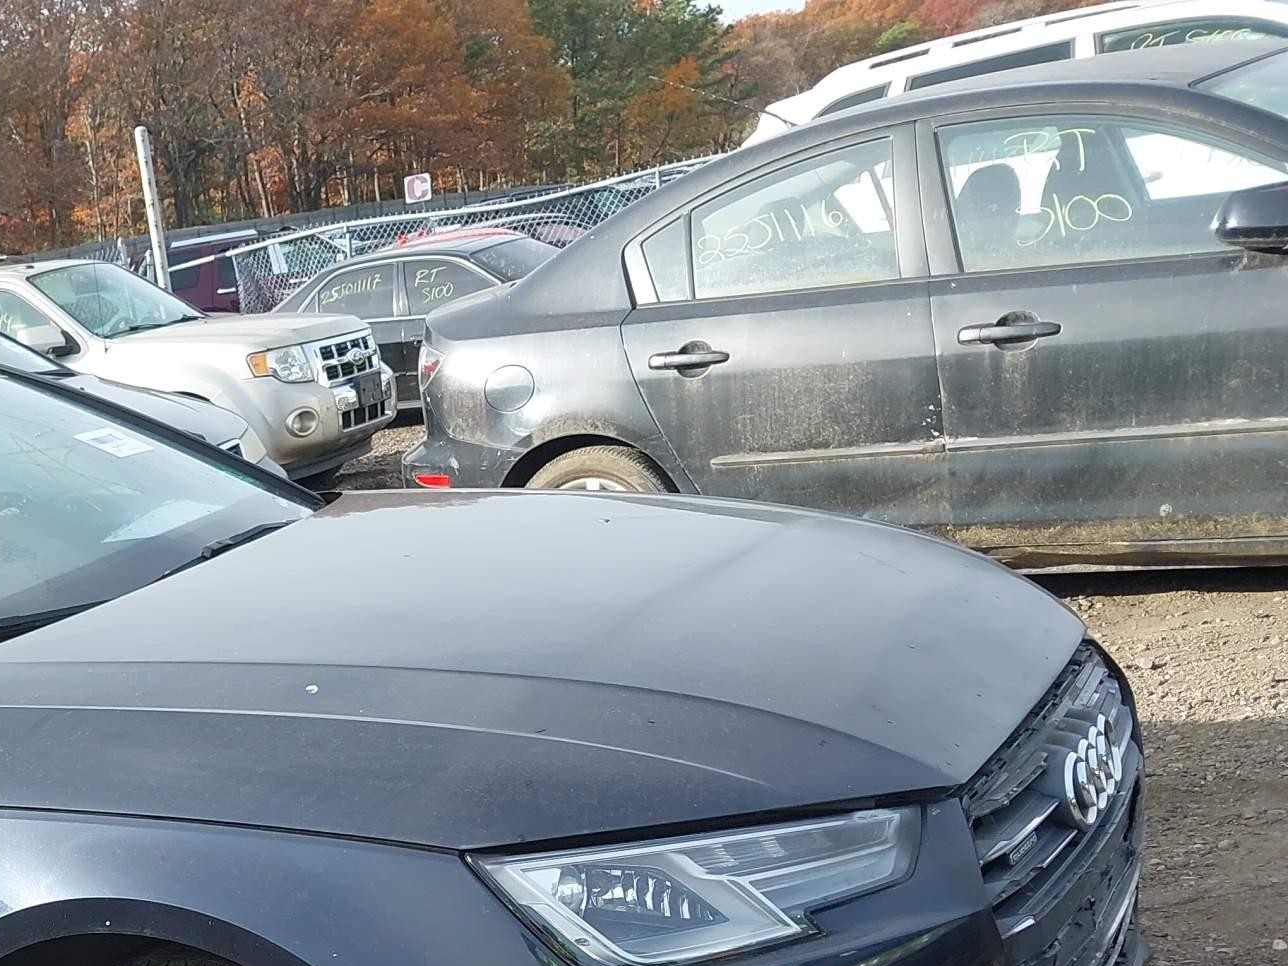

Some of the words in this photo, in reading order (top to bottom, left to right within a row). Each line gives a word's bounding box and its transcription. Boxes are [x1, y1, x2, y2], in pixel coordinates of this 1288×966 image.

[407, 175, 429, 201] C
[414, 266, 448, 288] RT
[422, 282, 455, 304] S100
